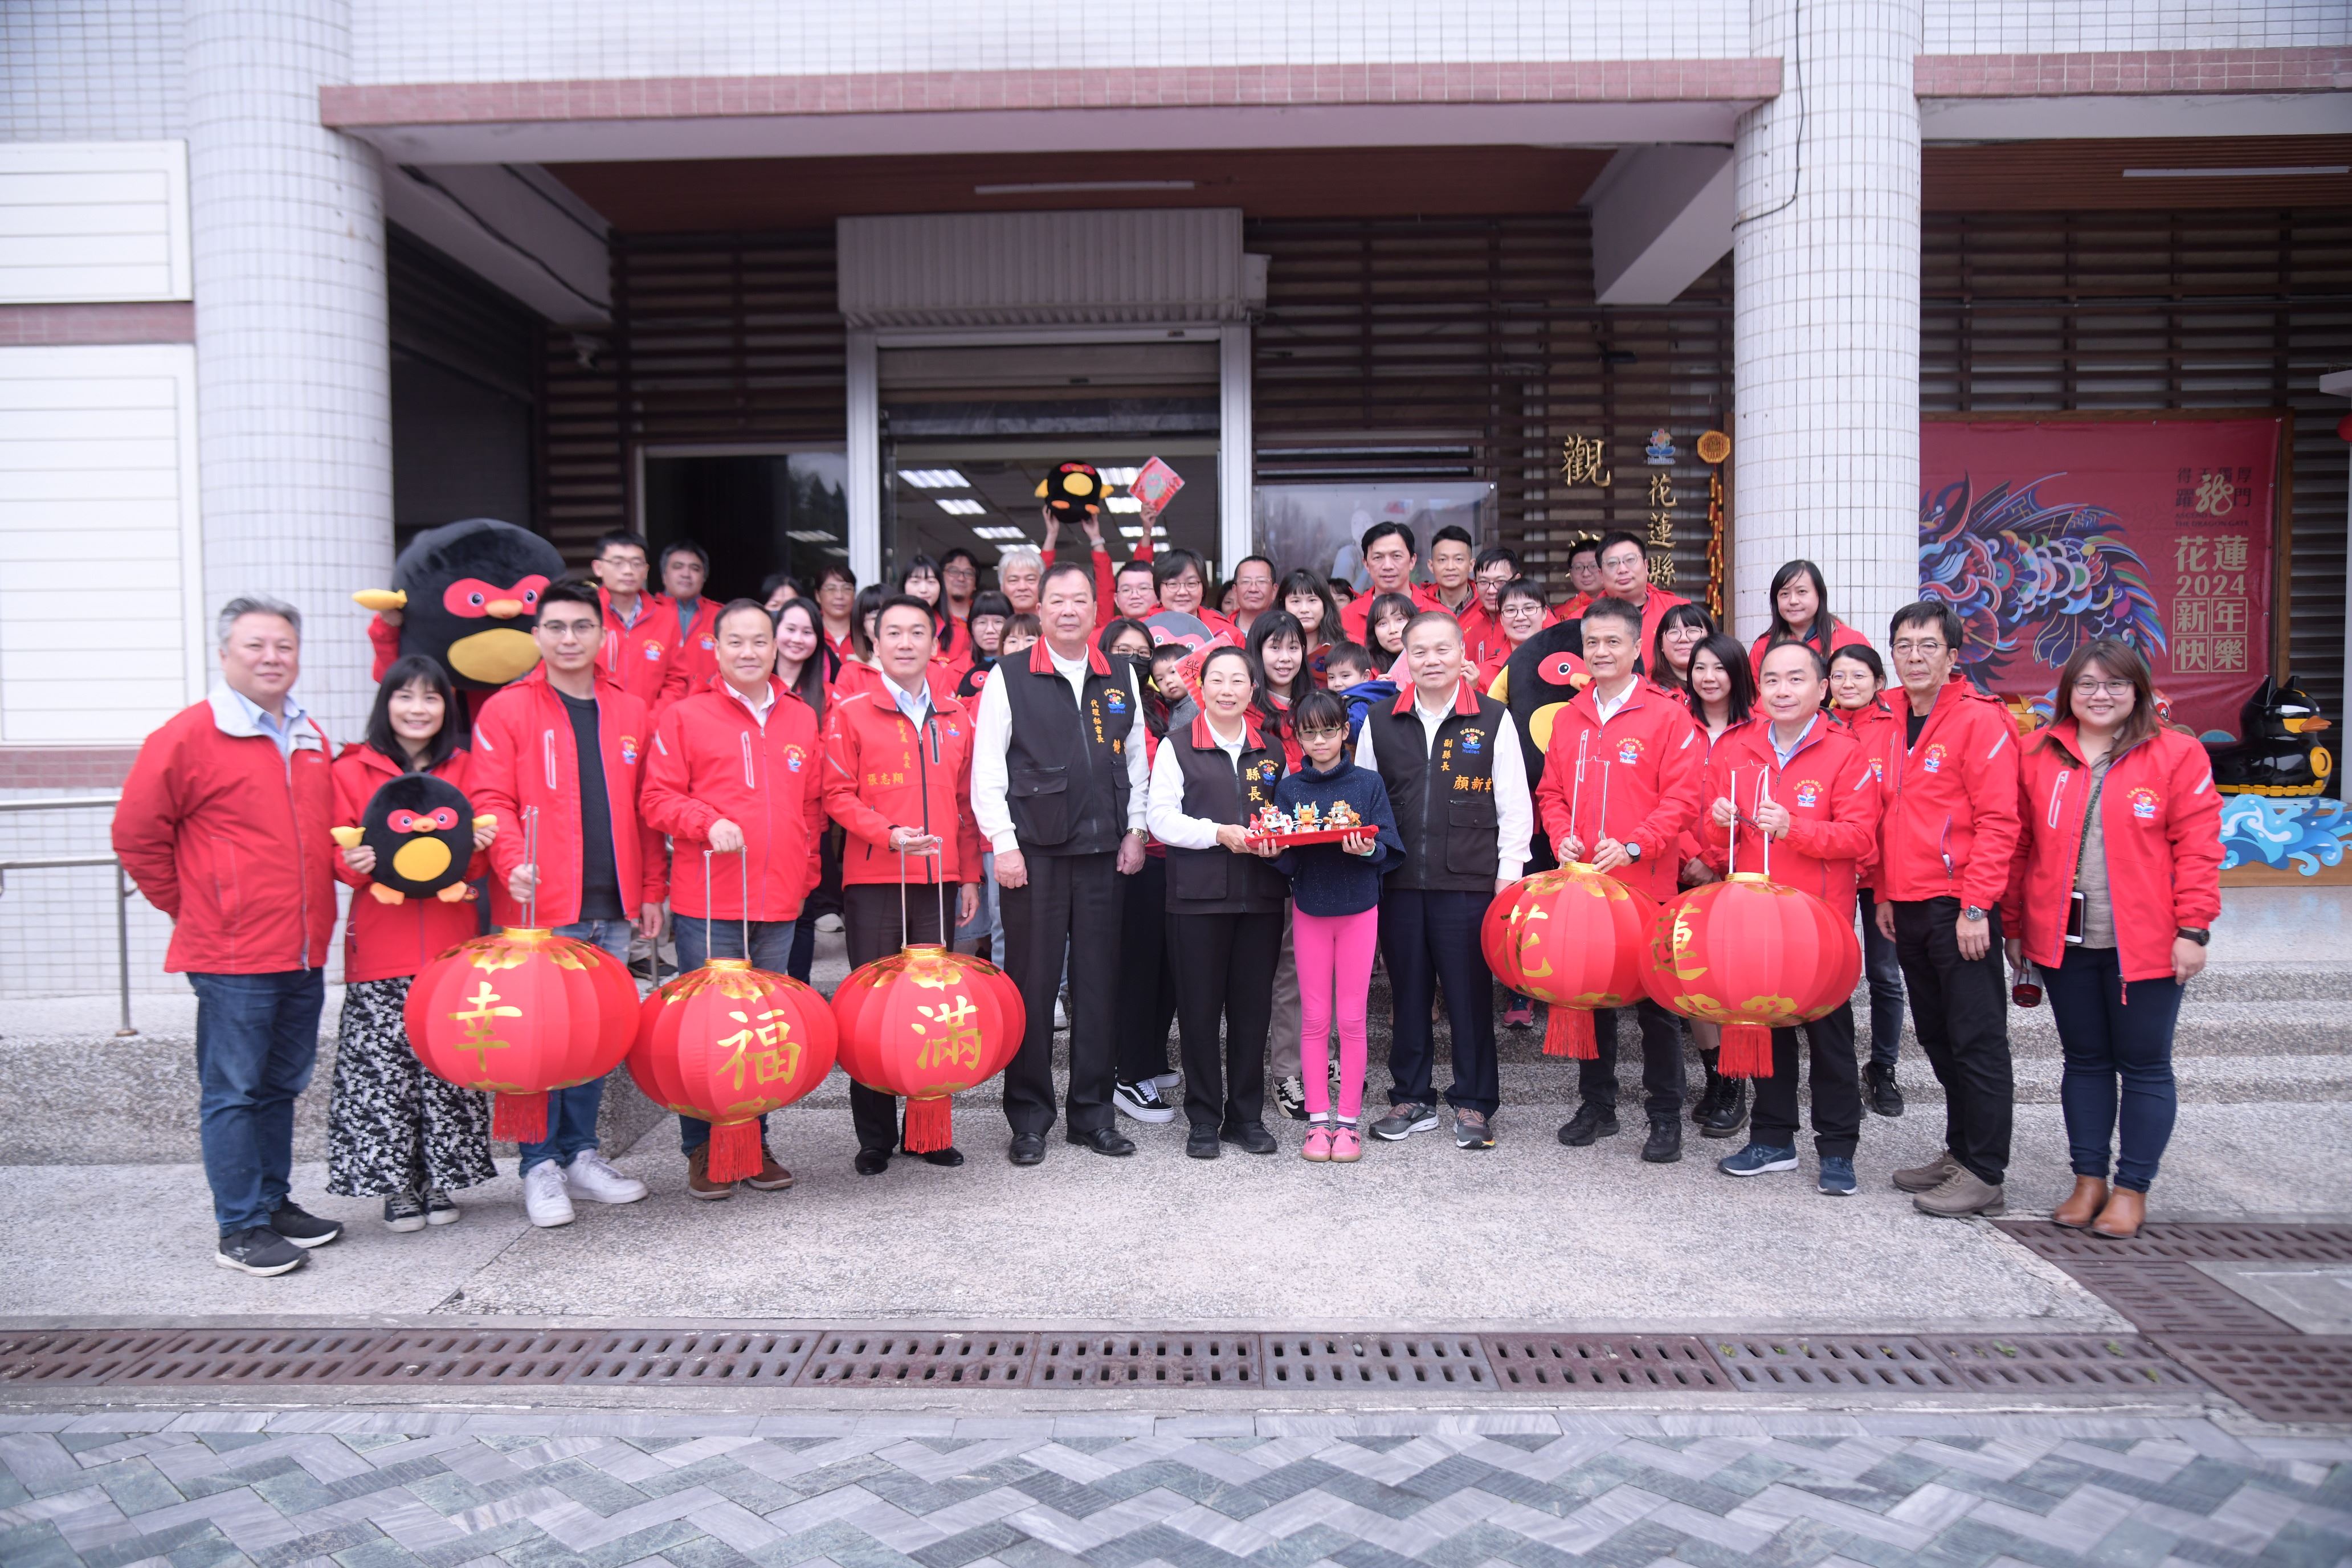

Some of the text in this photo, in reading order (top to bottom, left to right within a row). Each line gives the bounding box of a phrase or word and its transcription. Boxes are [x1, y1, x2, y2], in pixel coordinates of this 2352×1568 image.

[1648, 473, 1677, 587] 花蓮縣
[2174, 534, 2249, 572] 花蓮
[2176, 574, 2245, 597] 2024
[2177, 601, 2244, 632] 新年
[2176, 638, 2243, 670] 快樂
[1440, 738, 1453, 772] 副縣長
[867, 772, 904, 786] 張志翔
[1246, 767, 1263, 802] 縣長
[1494, 904, 1554, 978] 花
[1652, 902, 1709, 981] 蓮
[448, 981, 522, 1073] 幸
[912, 995, 983, 1071] 滿
[716, 1008, 802, 1091] 福
